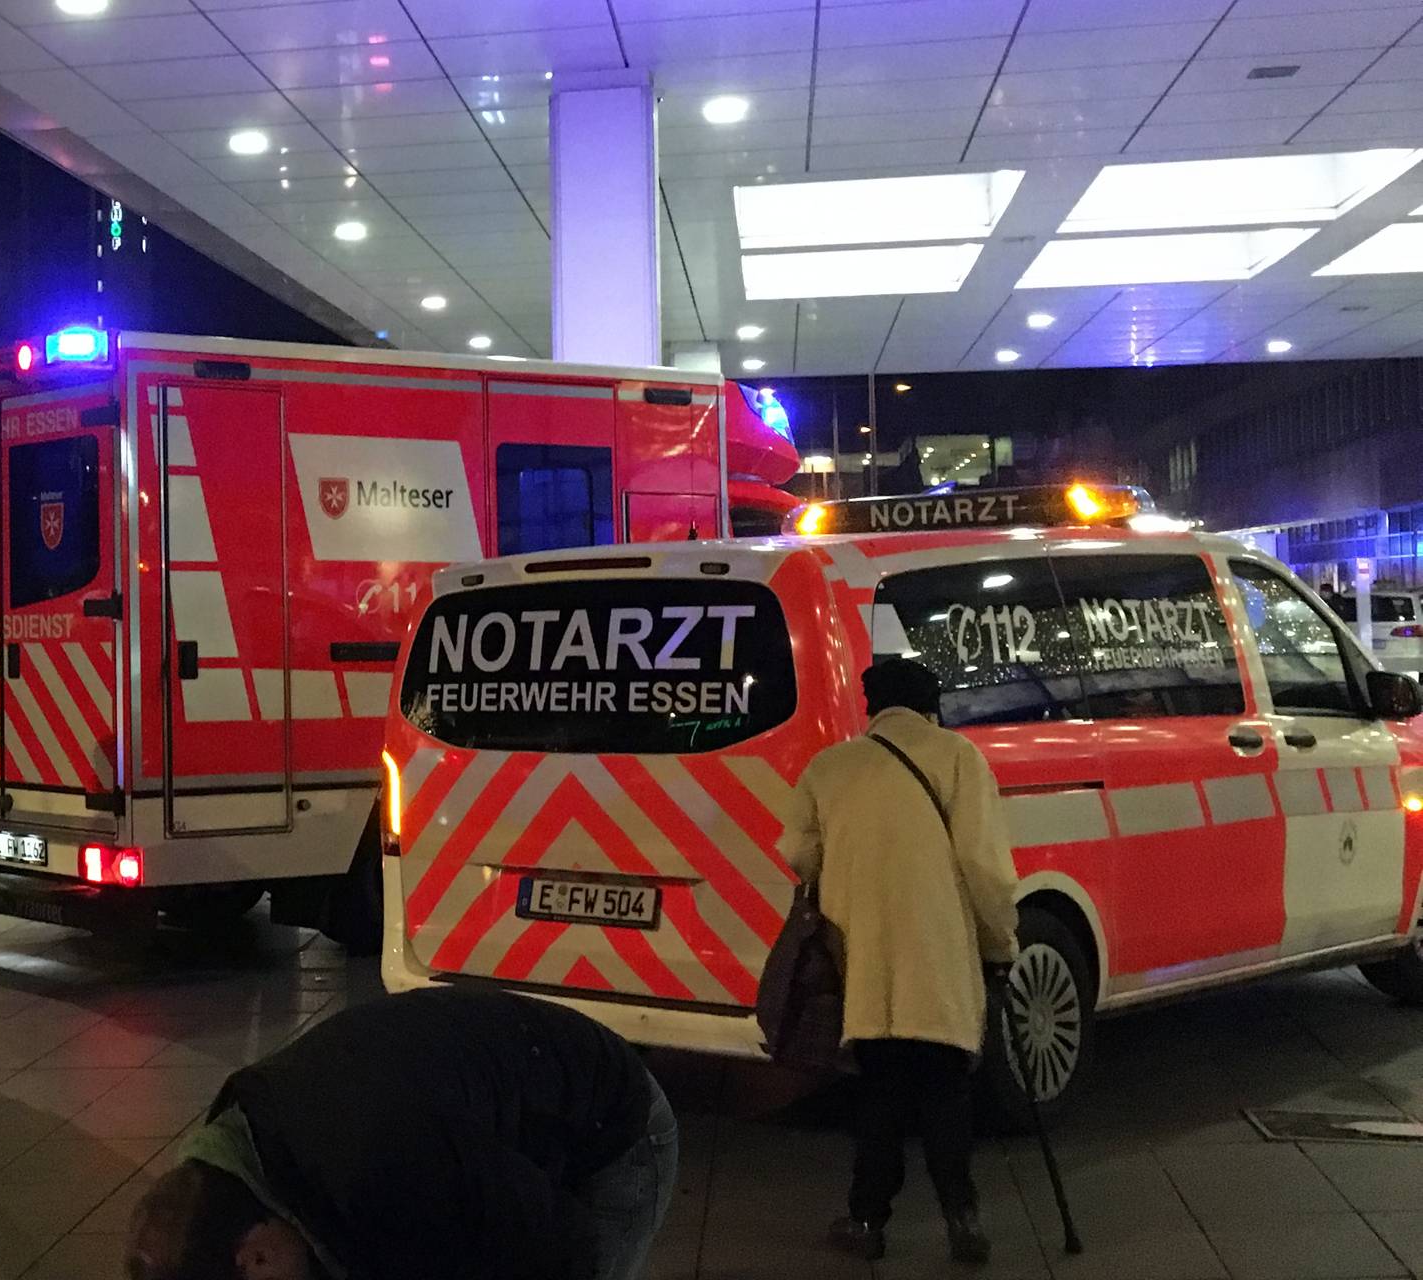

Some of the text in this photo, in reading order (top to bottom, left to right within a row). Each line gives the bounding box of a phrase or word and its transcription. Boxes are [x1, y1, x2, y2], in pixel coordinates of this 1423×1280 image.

[27, 408, 77, 435] ESSEN
[357, 481, 453, 508] Malteser
[869, 495, 1019, 529] NOTARZT
[389, 582, 417, 613] 11
[980, 604, 1043, 664] 112
[1079, 597, 1214, 643] NOTARZT
[427, 604, 756, 674] NOTARZT
[425, 680, 750, 715] FEUERWEHR ESSEN
[539, 884, 645, 917] E FW 504
